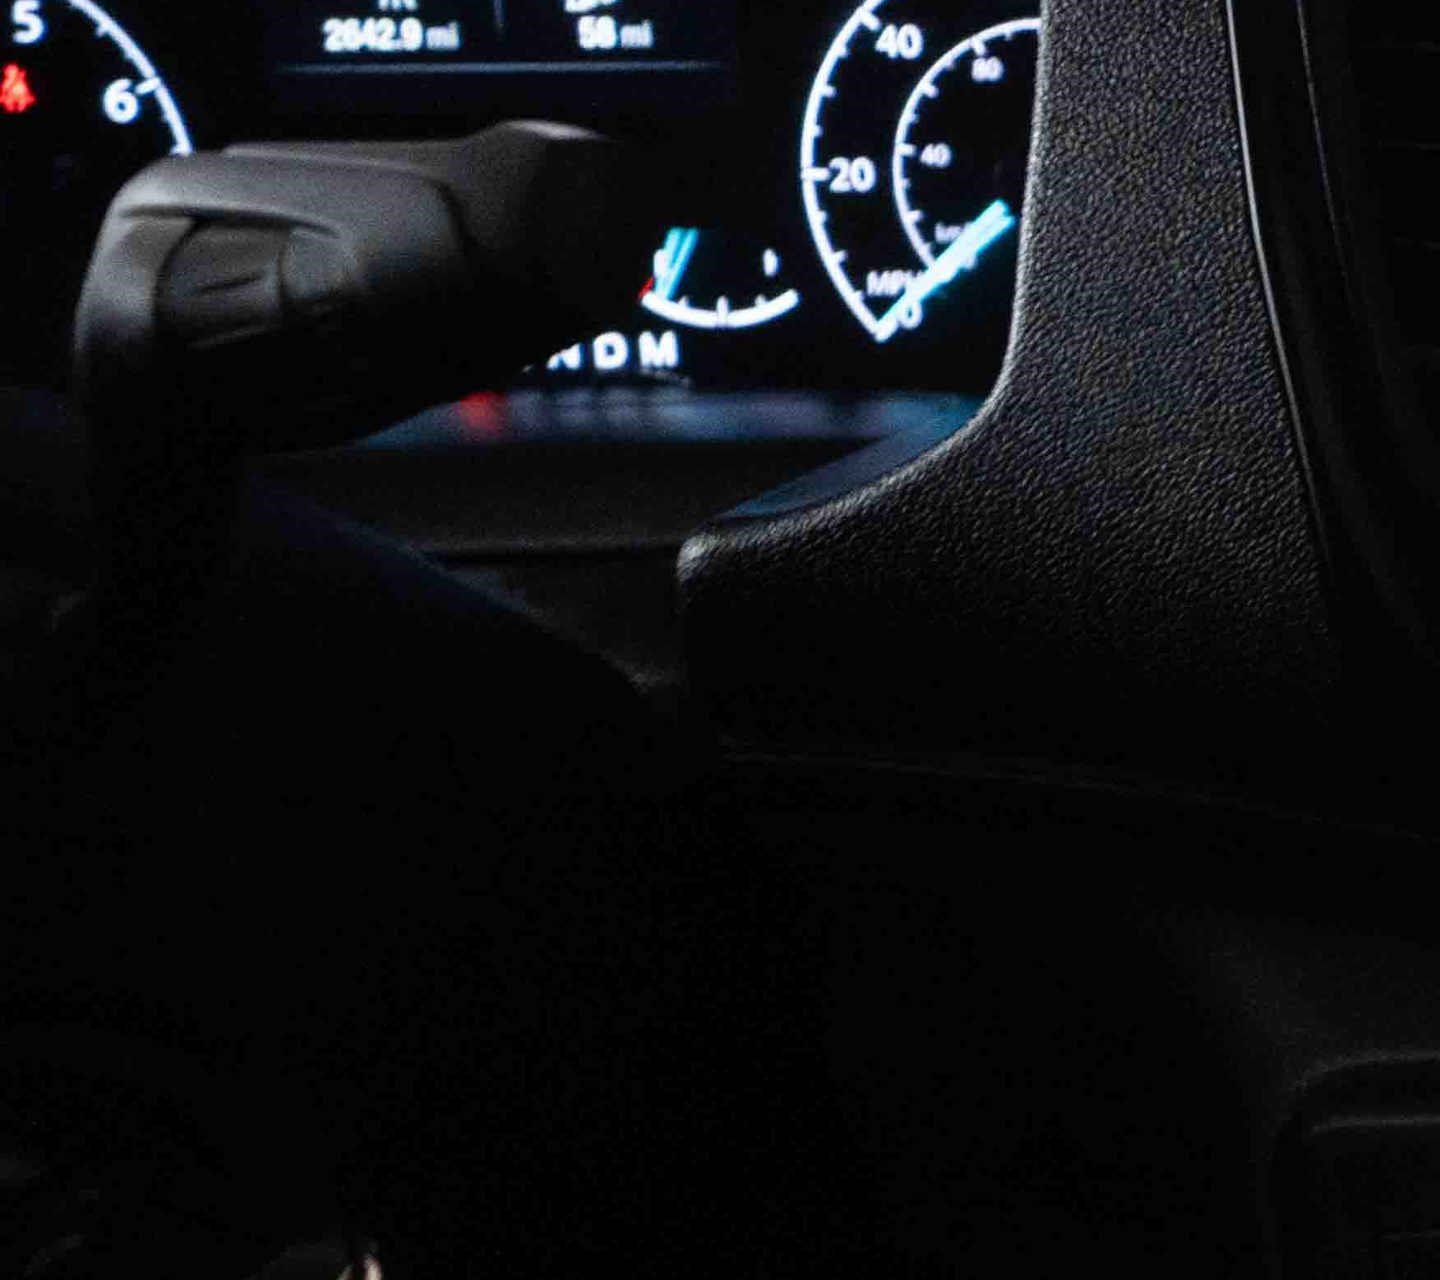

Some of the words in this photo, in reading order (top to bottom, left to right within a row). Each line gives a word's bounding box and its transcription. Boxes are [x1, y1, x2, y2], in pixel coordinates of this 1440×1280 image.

[425, 23, 460, 49] mi
[619, 21, 653, 47] mi
[875, 20, 924, 59] 40
[103, 79, 140, 123] 6
[920, 144, 951, 167] 40
[828, 157, 876, 192] 20
[593, 332, 630, 370] D
[639, 331, 679, 368] M
